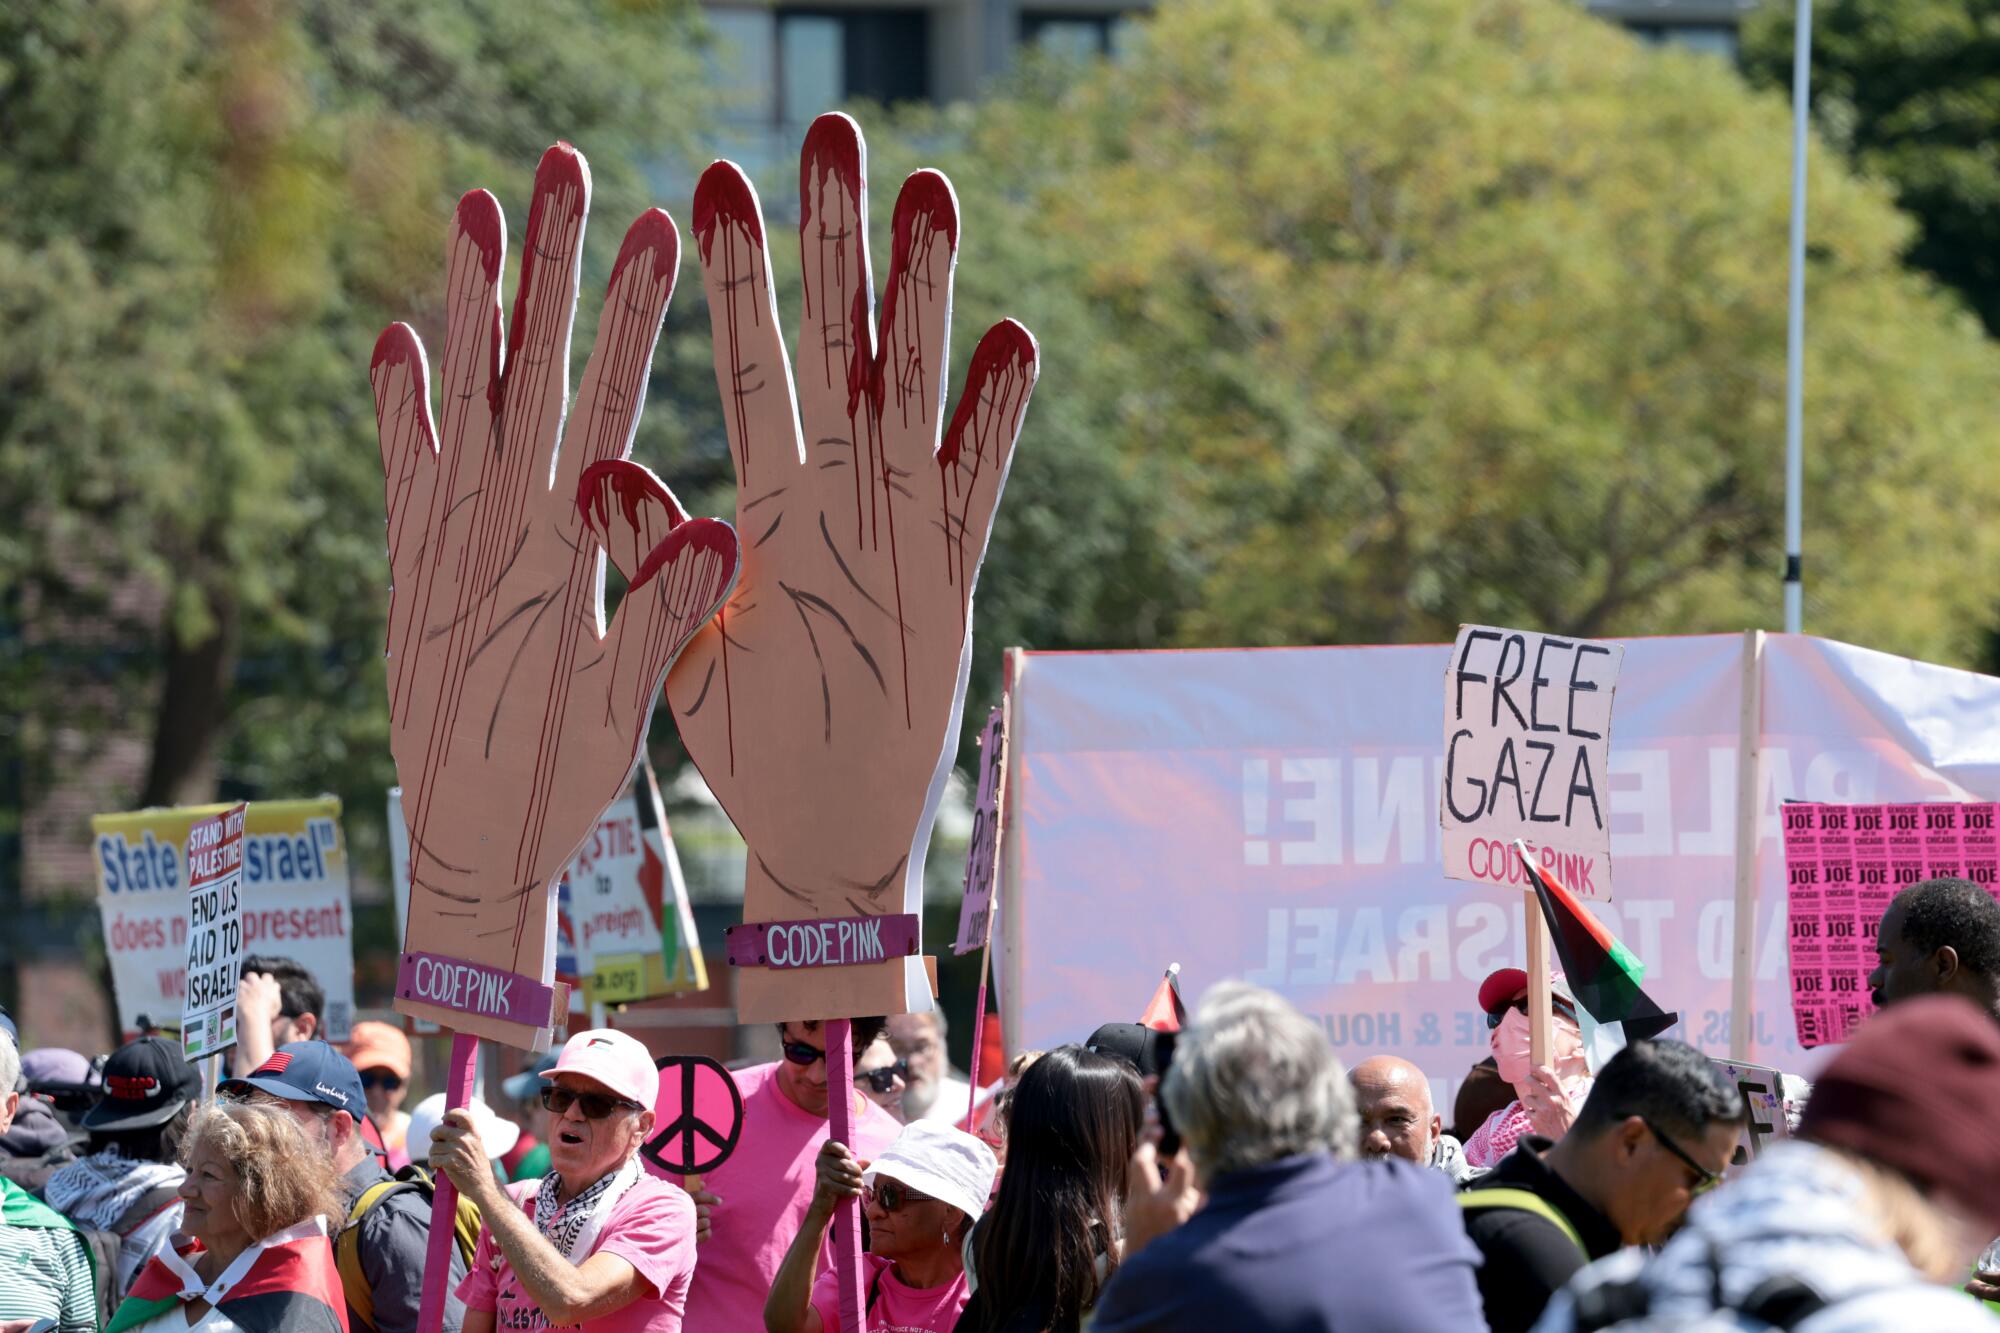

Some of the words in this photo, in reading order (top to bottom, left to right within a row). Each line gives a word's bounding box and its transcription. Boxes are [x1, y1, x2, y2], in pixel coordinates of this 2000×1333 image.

[1456, 629, 1610, 740] FREE
[1445, 729, 1603, 830] GAZA
[1786, 814, 1815, 829] JOE
[1820, 814, 1850, 829] JOE
[1854, 815, 1883, 830] JOE
[1889, 815, 1919, 830] JOE
[1925, 814, 1958, 829] JOE
[1963, 814, 1994, 829] JOE
[190, 821, 223, 852] STAND
[225, 810, 244, 839] WITH
[102, 834, 178, 893] State
[189, 838, 242, 880] PALESTINE!
[1790, 869, 1819, 884] JOE
[1824, 867, 1854, 883] JOE
[1858, 869, 1888, 884] JOE
[1893, 869, 1923, 884] JOE
[1968, 868, 1998, 883] JOE
[192, 890, 217, 928] END
[111, 911, 165, 951] does
[1792, 922, 1820, 938] JOE
[1826, 922, 1856, 937] JOE
[188, 930, 217, 970] AID
[222, 918, 239, 958] TO
[767, 918, 885, 967] CODEPINK
[187, 961, 237, 1012] ISRAEL!
[415, 956, 513, 1015] CODEPINK
[1795, 976, 1824, 992] JOE
[1829, 976, 1859, 992] JOE
[1801, 1009, 1818, 1041] JOE
